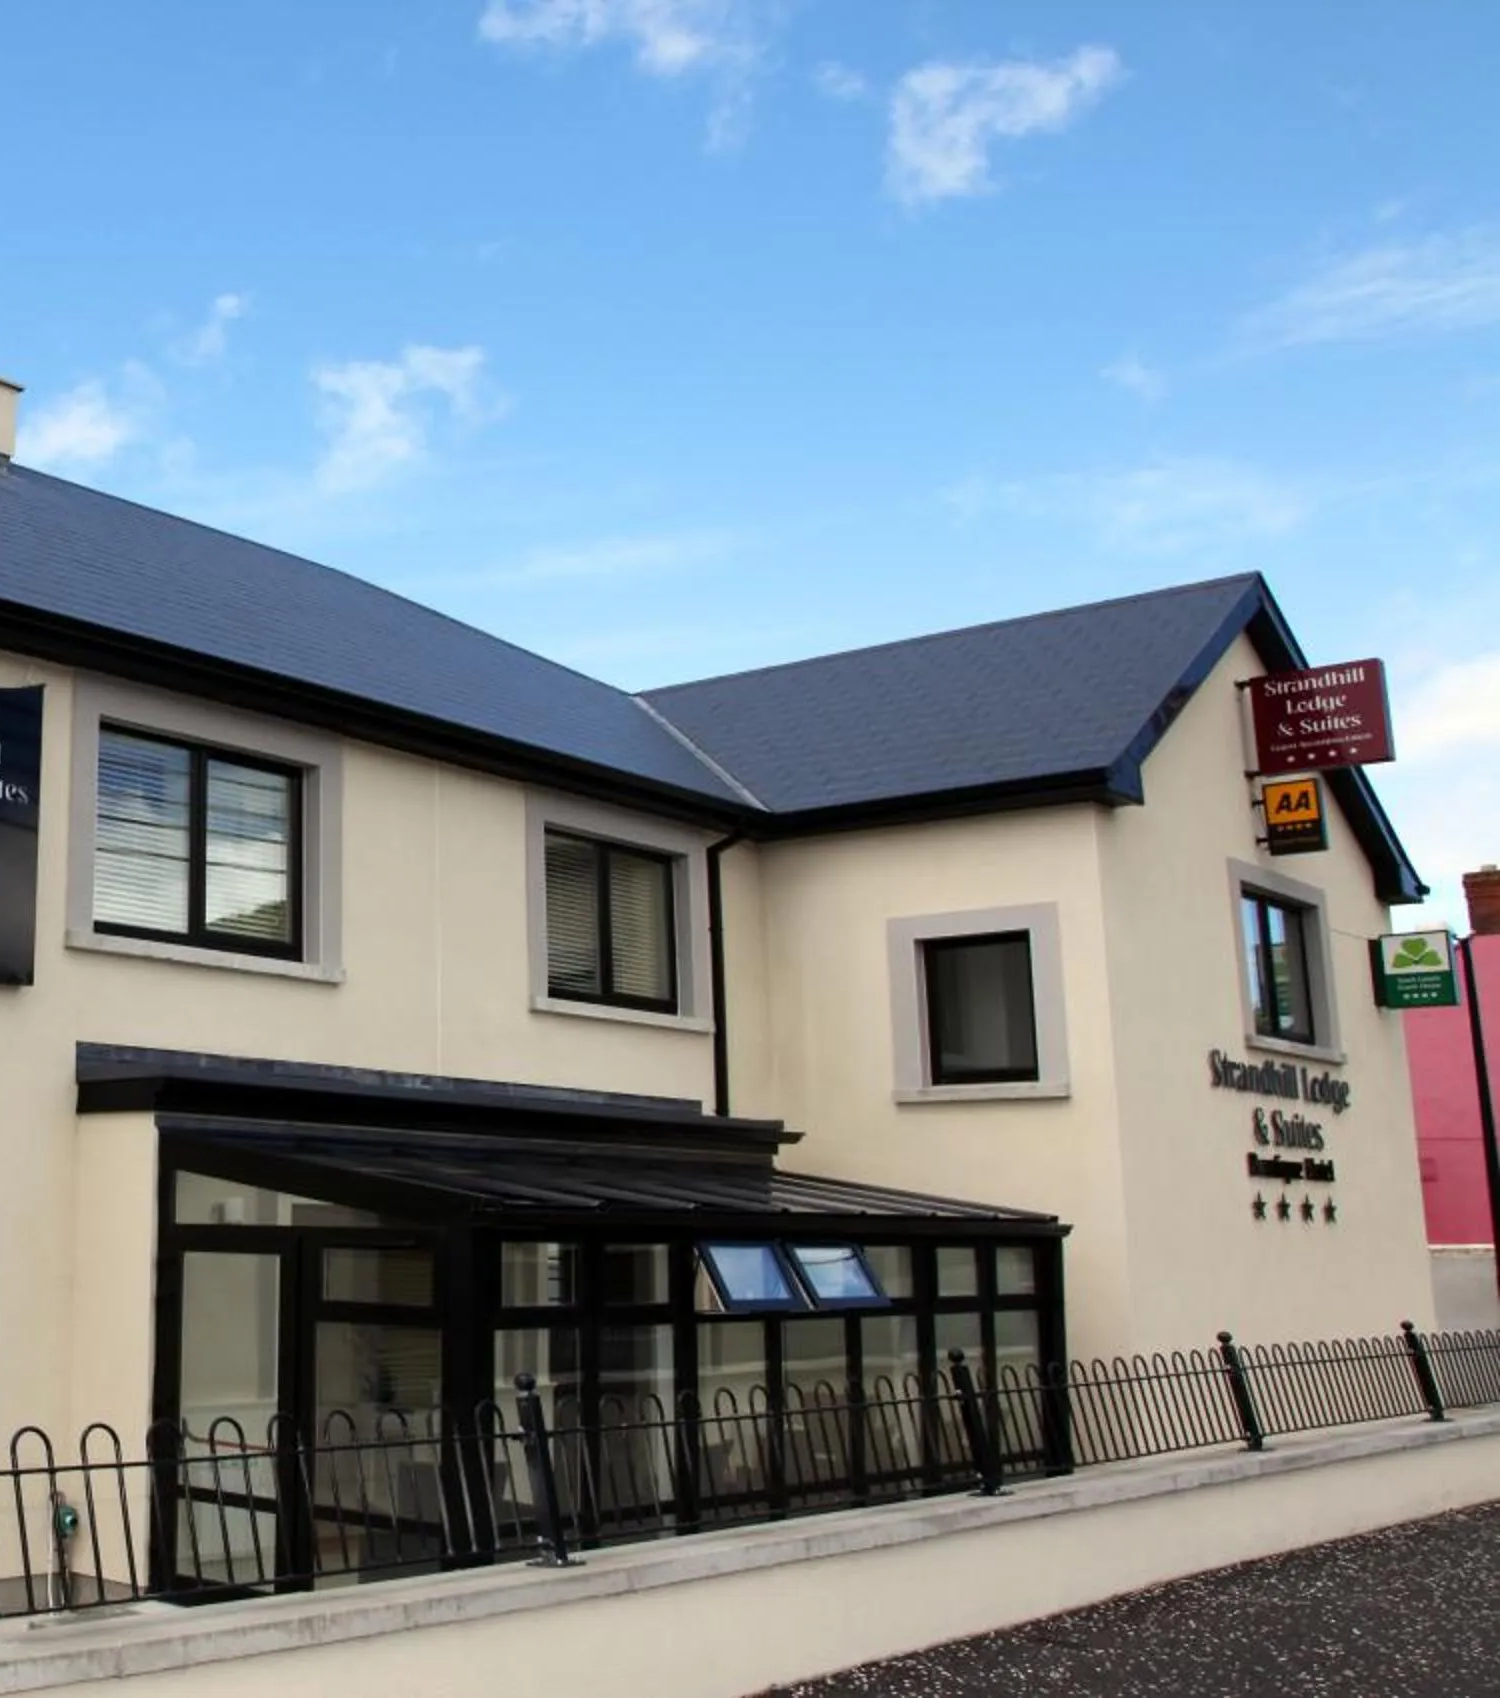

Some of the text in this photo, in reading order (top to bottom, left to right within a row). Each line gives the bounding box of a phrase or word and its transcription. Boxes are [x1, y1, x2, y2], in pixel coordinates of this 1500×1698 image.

[1264, 666, 1365, 697] Strandhill
[1286, 694, 1347, 715] Lodge
[1277, 714, 1363, 737] & Suites
[1275, 790, 1311, 815] AA
[1209, 1049, 1351, 1115] Strandhill Lodge
[1253, 1107, 1325, 1151] & Suites
